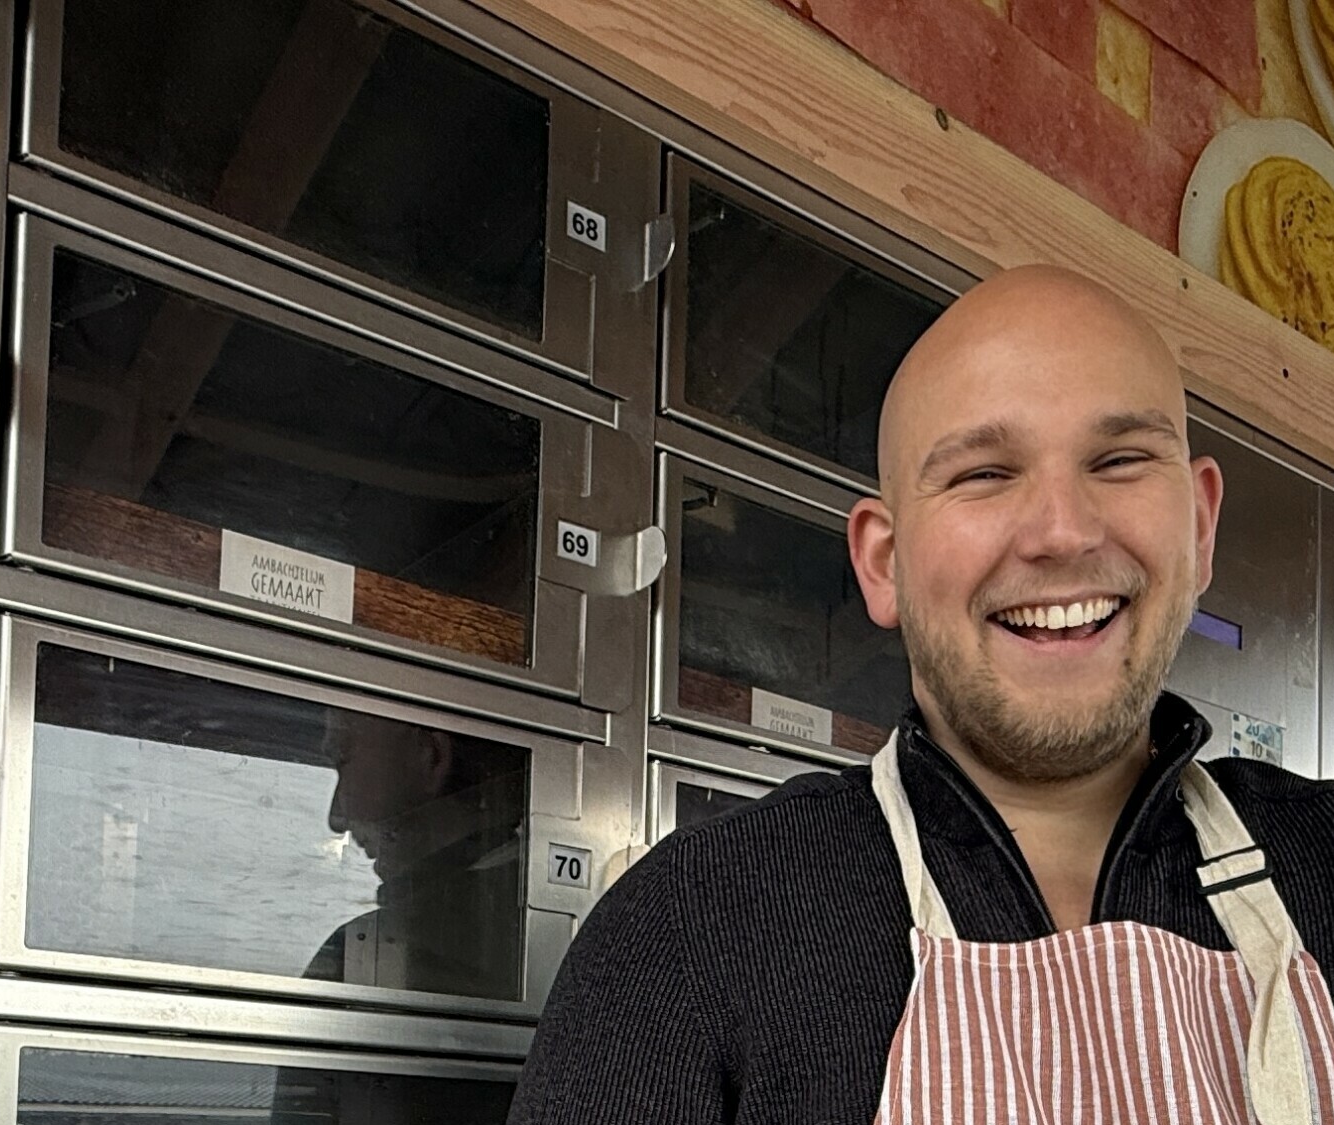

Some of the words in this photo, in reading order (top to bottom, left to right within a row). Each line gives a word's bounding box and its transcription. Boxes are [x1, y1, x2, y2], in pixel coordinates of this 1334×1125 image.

[573, 212, 598, 241] 68
[563, 531, 589, 557] 69
[251, 554, 326, 586] AMBACHTELIJK
[251, 572, 324, 609] GEMAAKT
[1251, 741, 1263, 758] 10
[555, 855, 581, 880] 70
